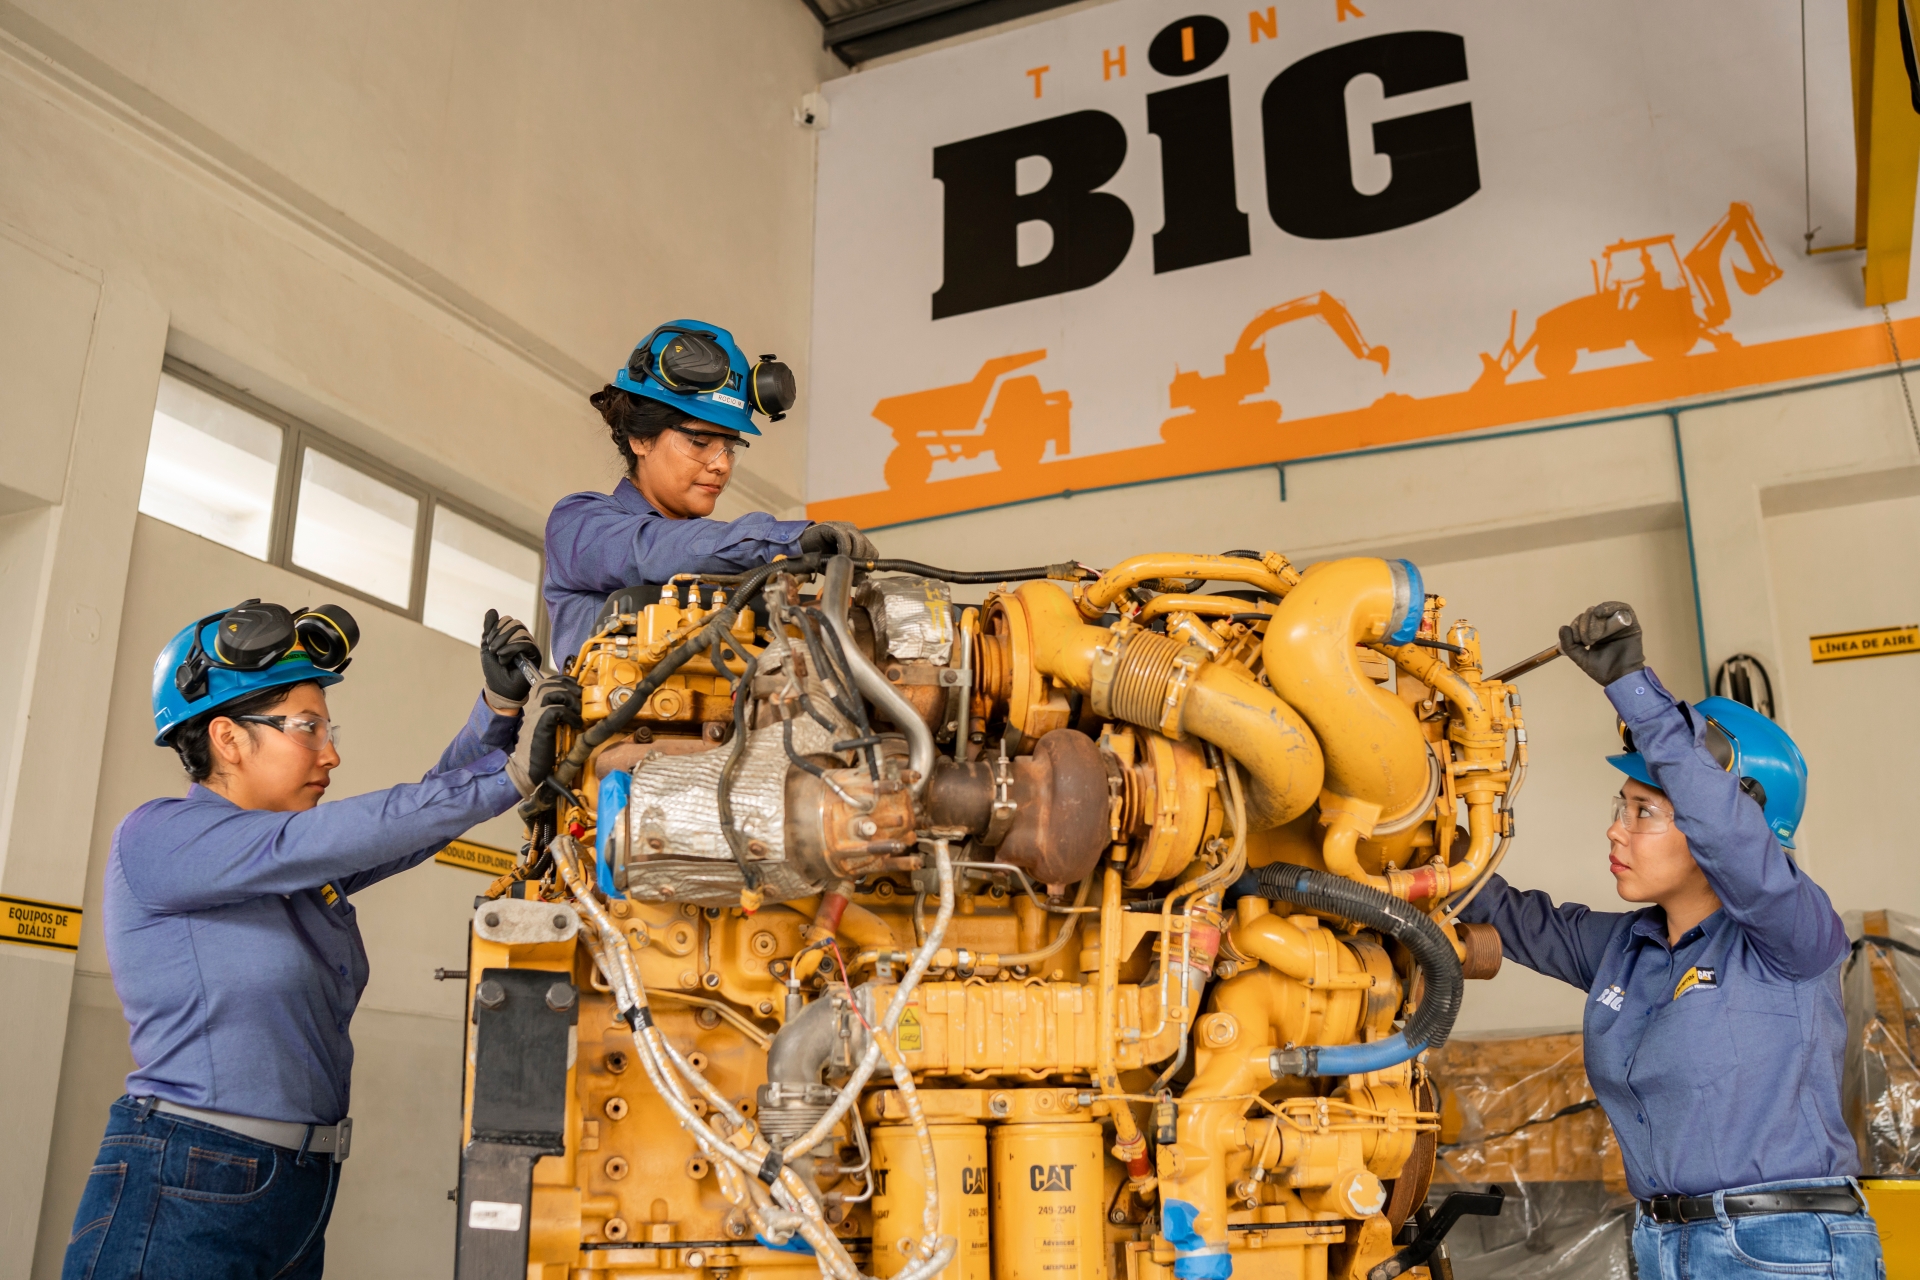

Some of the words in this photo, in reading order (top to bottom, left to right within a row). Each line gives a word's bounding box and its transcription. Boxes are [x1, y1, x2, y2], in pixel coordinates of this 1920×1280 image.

[724, 369, 743, 392] AT
[1818, 641, 1858, 654] LÍNEA
[1862, 637, 1878, 649] DE
[1883, 634, 1914, 647] AIRE
[9, 906, 53, 924] EQUIPOS
[55, 914, 68, 927] DE
[1697, 970, 1712, 981] CAT
[872, 1168, 888, 1197] AT
[1030, 1164, 1075, 1192] CAT
[1038, 1205, 1076, 1215] 249-2347
[1042, 1239, 1075, 1247] Advanced
